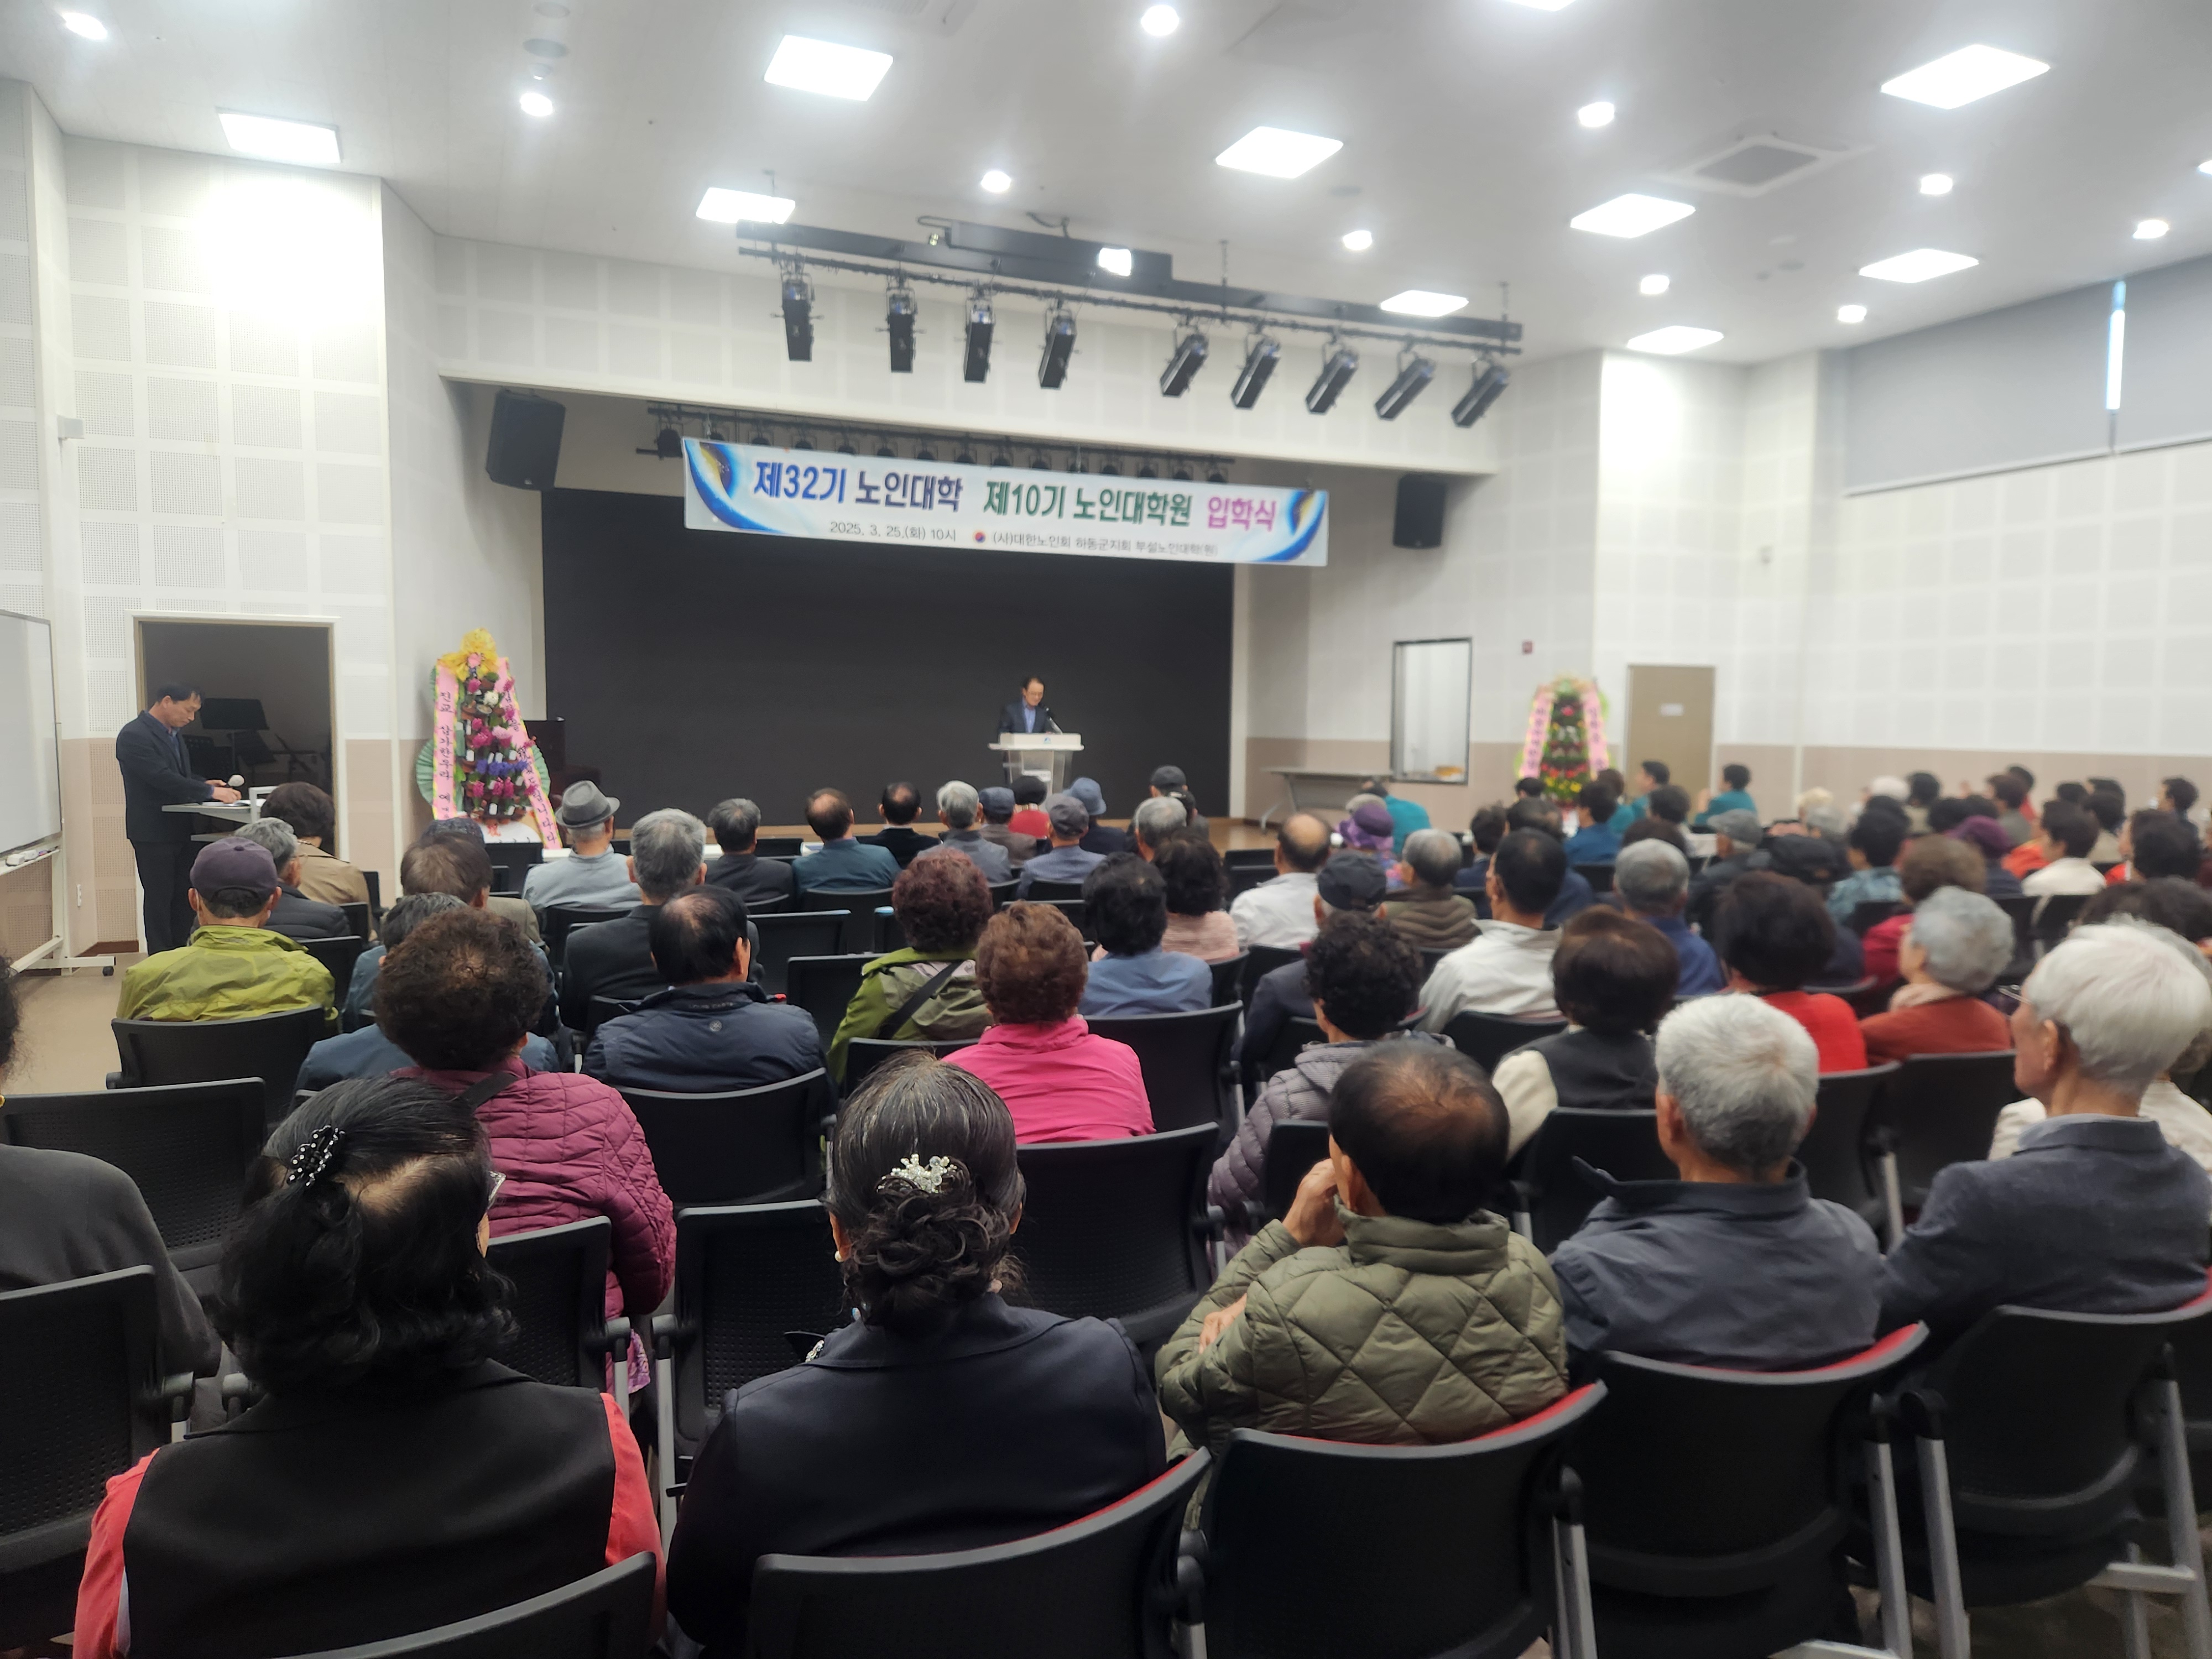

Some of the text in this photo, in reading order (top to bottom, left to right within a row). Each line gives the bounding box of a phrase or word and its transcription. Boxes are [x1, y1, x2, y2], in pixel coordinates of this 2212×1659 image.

[754, 461, 1277, 533] 제32기 노인대학 제10기 노인대학원 입학식
[830, 521, 864, 536] 2025.
[931, 529, 957, 541] 10시
